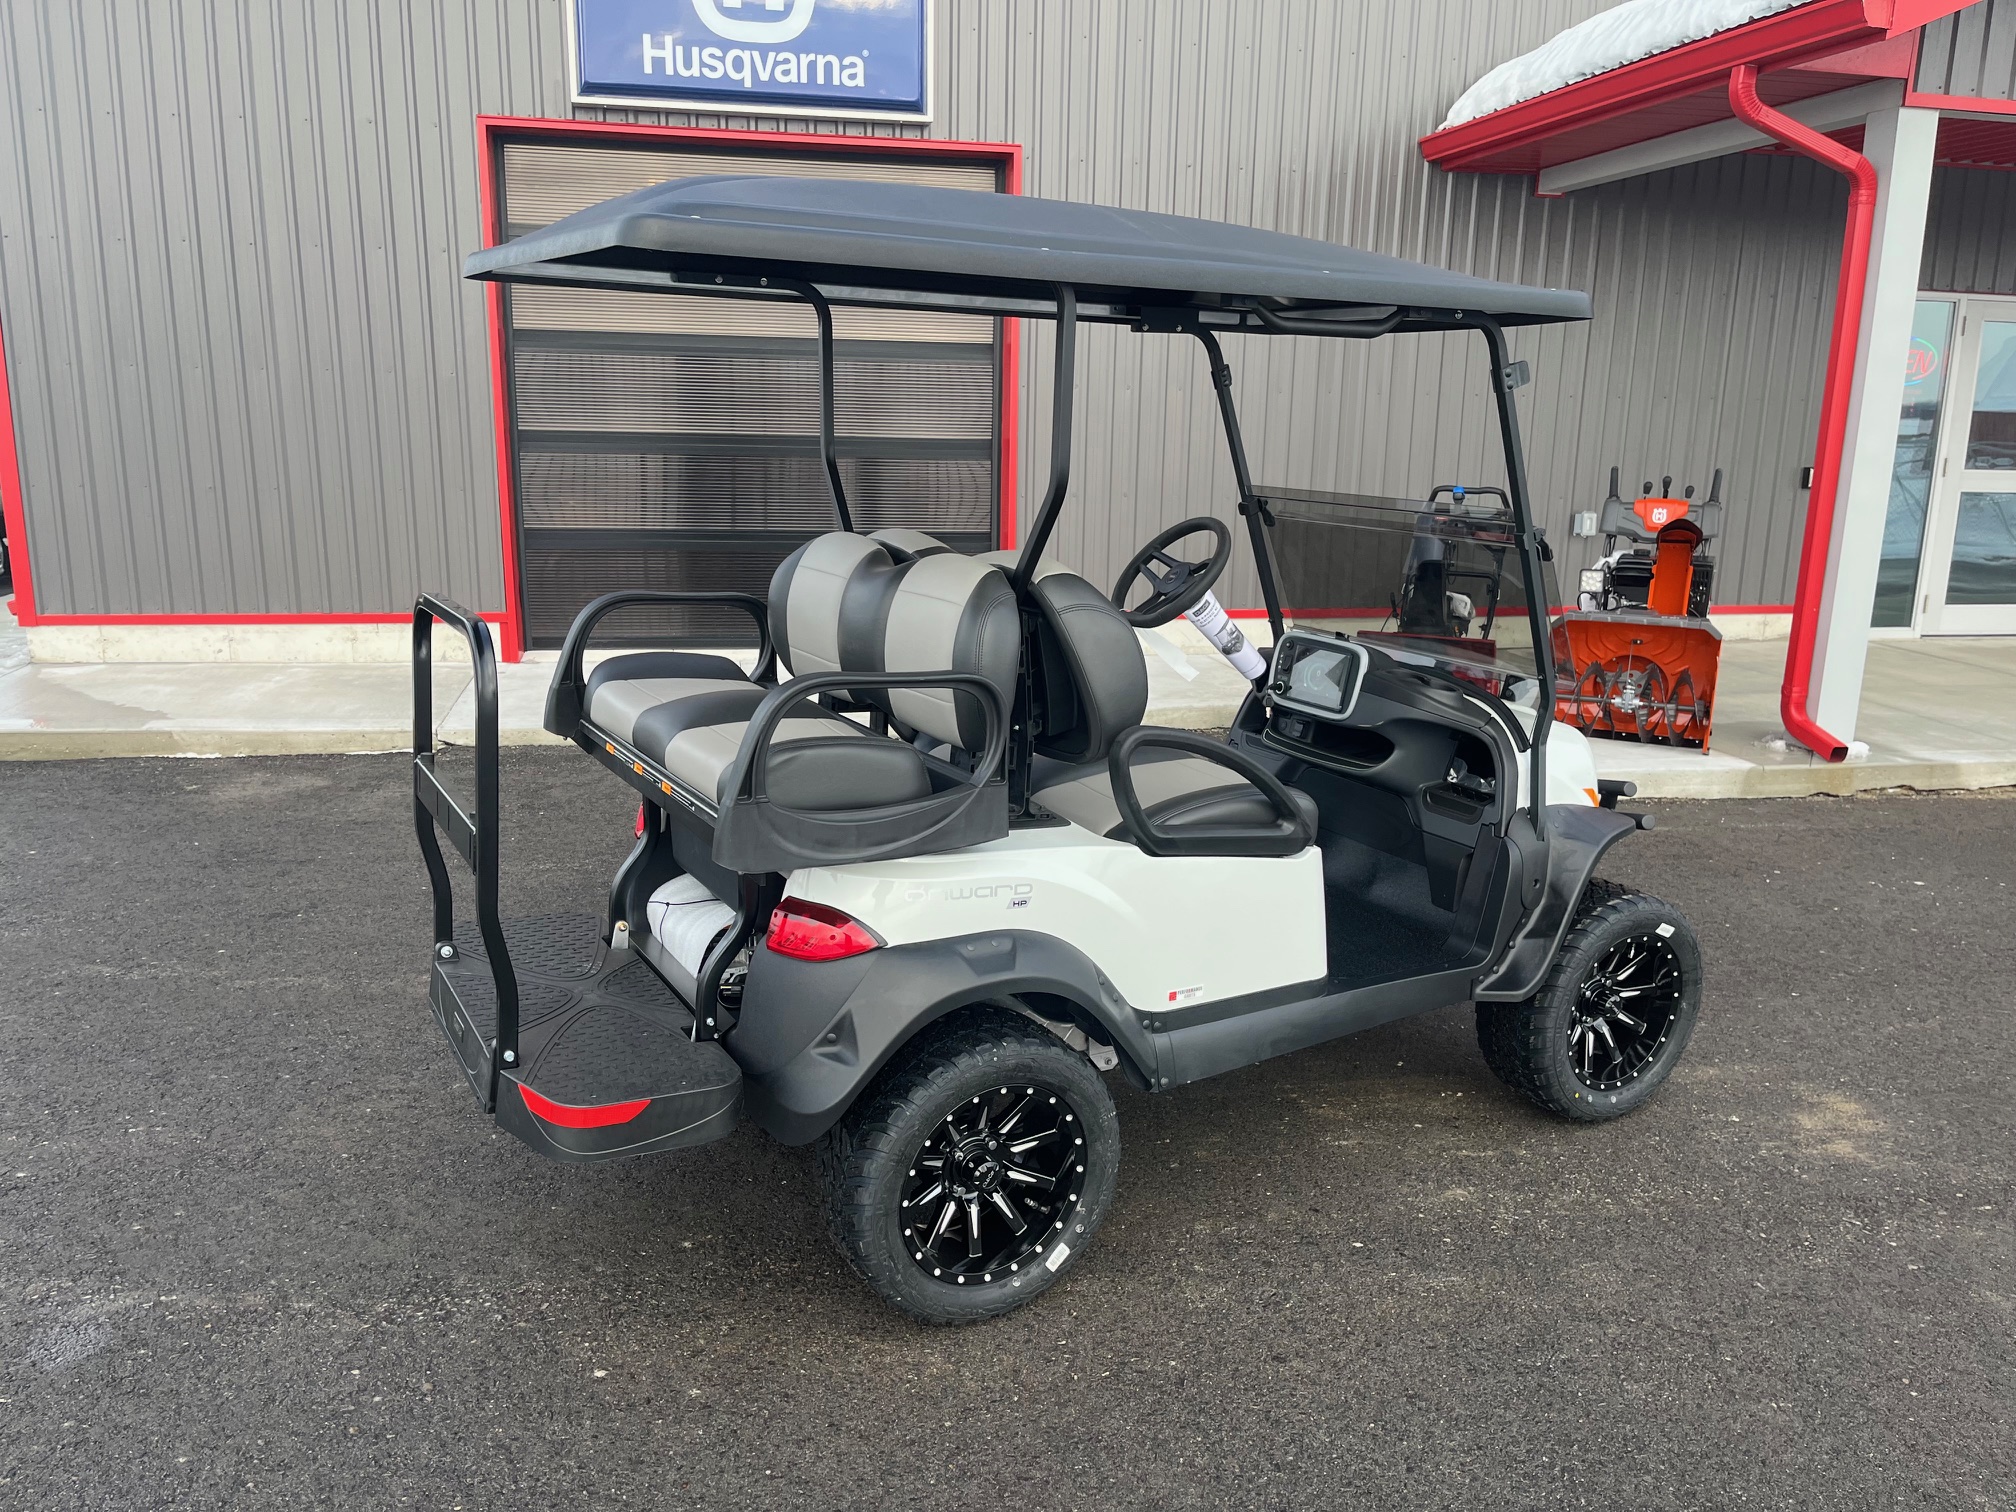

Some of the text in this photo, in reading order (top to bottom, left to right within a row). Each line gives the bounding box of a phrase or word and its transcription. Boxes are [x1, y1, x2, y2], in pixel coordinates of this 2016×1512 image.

[642, 33, 866, 88] Husqvarna
[1905, 350, 1933, 373] EN
[1012, 899, 1028, 907] HP
